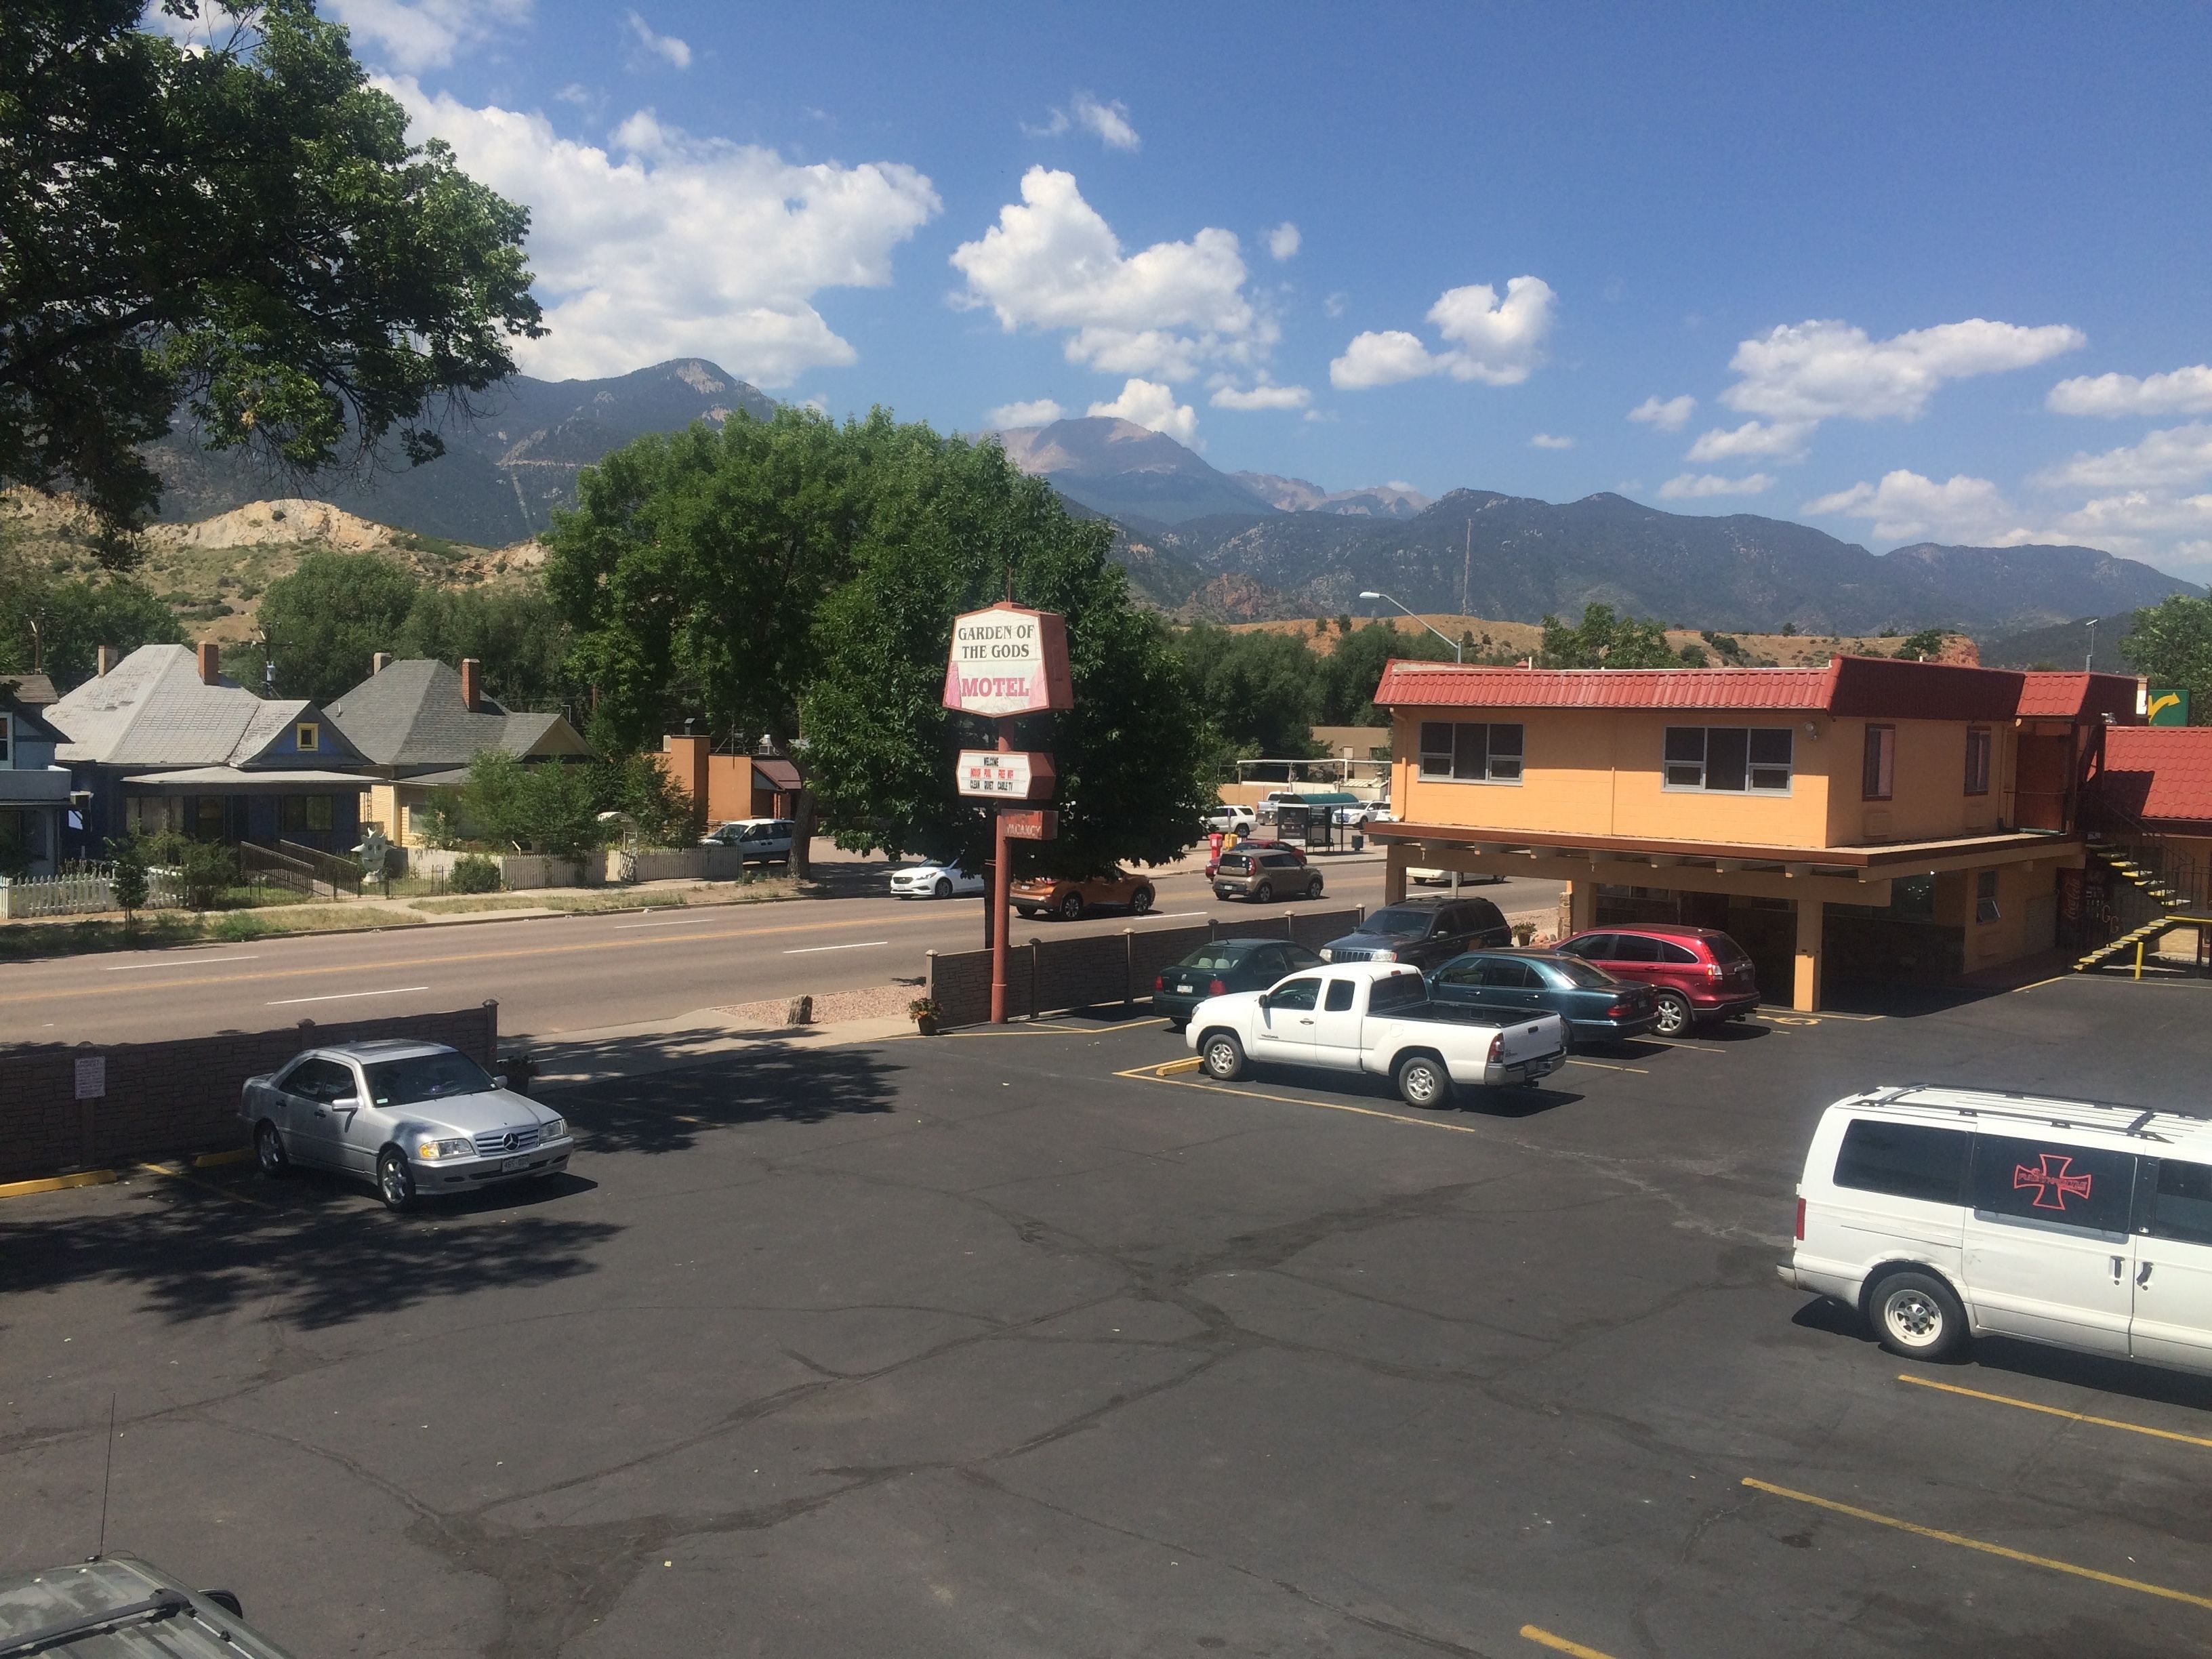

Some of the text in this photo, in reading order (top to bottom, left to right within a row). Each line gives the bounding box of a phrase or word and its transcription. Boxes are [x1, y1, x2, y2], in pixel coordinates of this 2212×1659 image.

[958, 625, 1034, 640] GARDEN OF
[962, 644, 1029, 658] THE GODS
[961, 678, 1029, 697] MOTEL
[983, 757, 999, 766] WELCOME
[1008, 782, 1013, 791] TV
